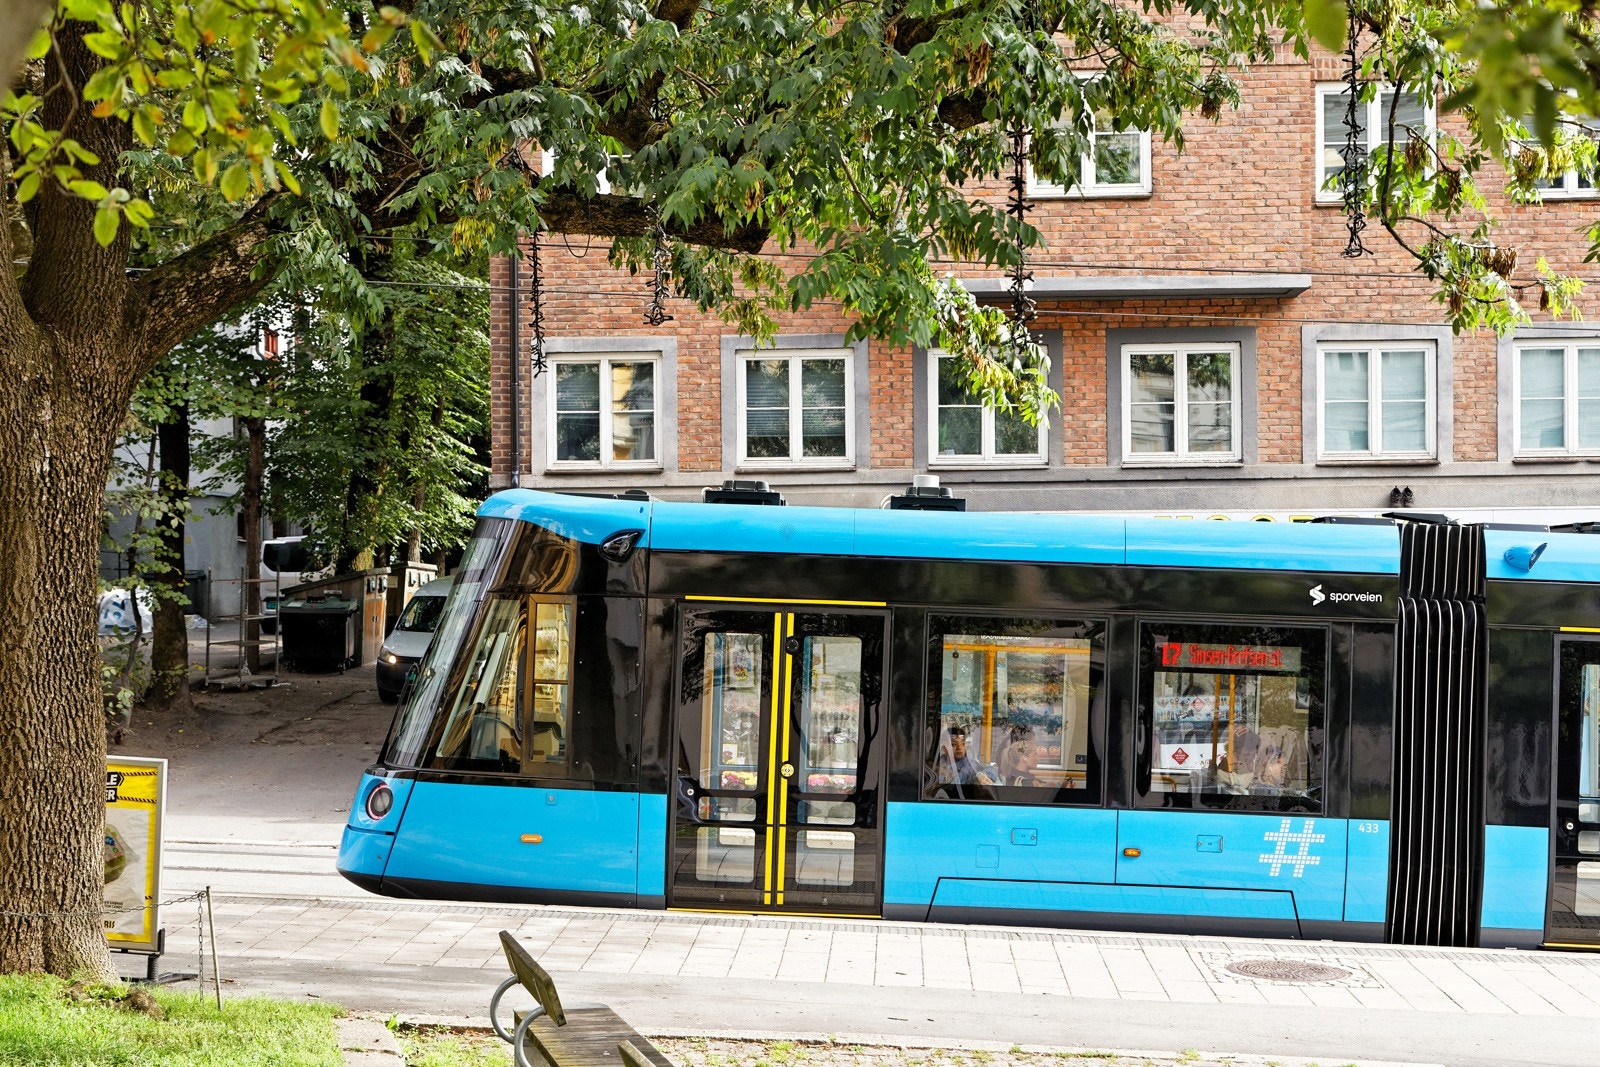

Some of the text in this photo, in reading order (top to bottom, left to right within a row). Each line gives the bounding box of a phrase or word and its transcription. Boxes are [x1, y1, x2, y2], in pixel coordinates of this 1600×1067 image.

[1329, 591, 1383, 604] sporveien
[1162, 643, 1182, 666] 17
[1358, 822, 1379, 834] 433
